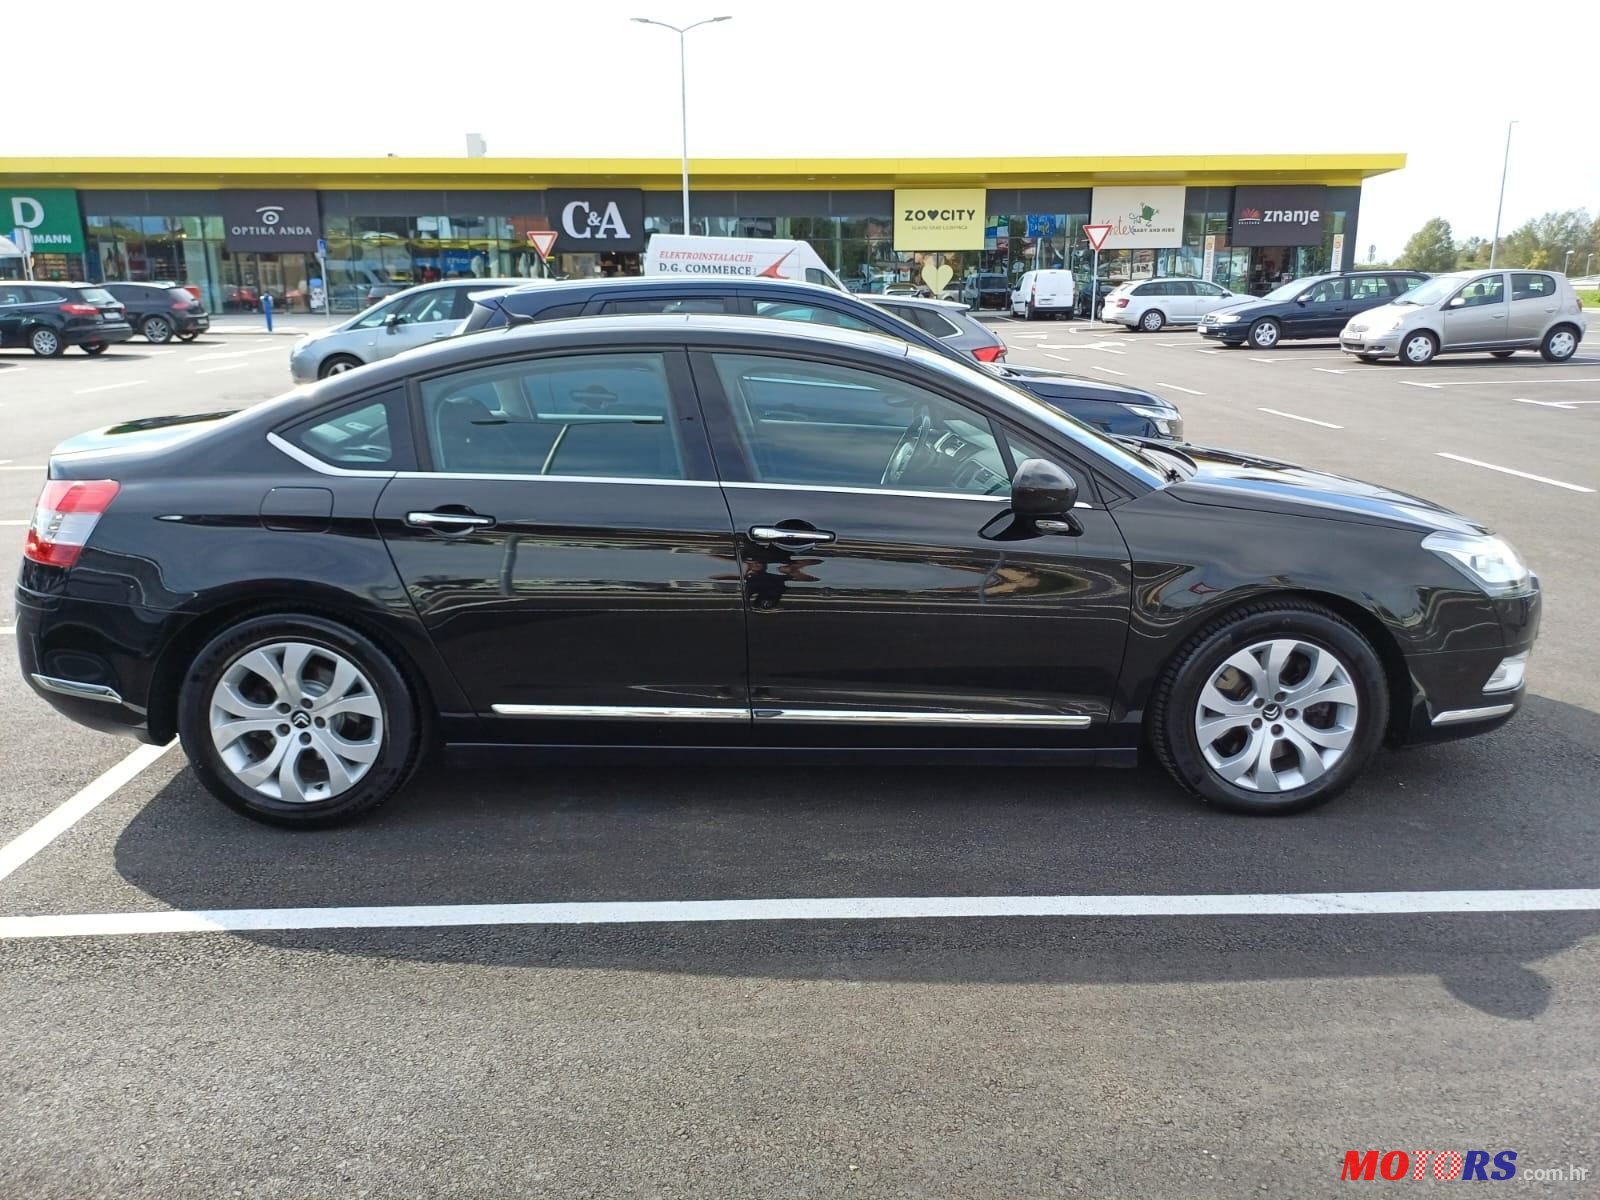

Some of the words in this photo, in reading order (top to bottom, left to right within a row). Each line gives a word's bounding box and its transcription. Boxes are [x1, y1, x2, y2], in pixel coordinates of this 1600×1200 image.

[11, 197, 45, 229] D
[562, 201, 631, 239] C&A
[1263, 208, 1320, 226] znanje
[231, 226, 275, 235] OPTIKA
[279, 226, 312, 235] ANDA
[659, 250, 753, 263] ELEKTROINSTALACIJE
[659, 262, 682, 272] D.G.
[685, 263, 752, 275] COMMERCE
